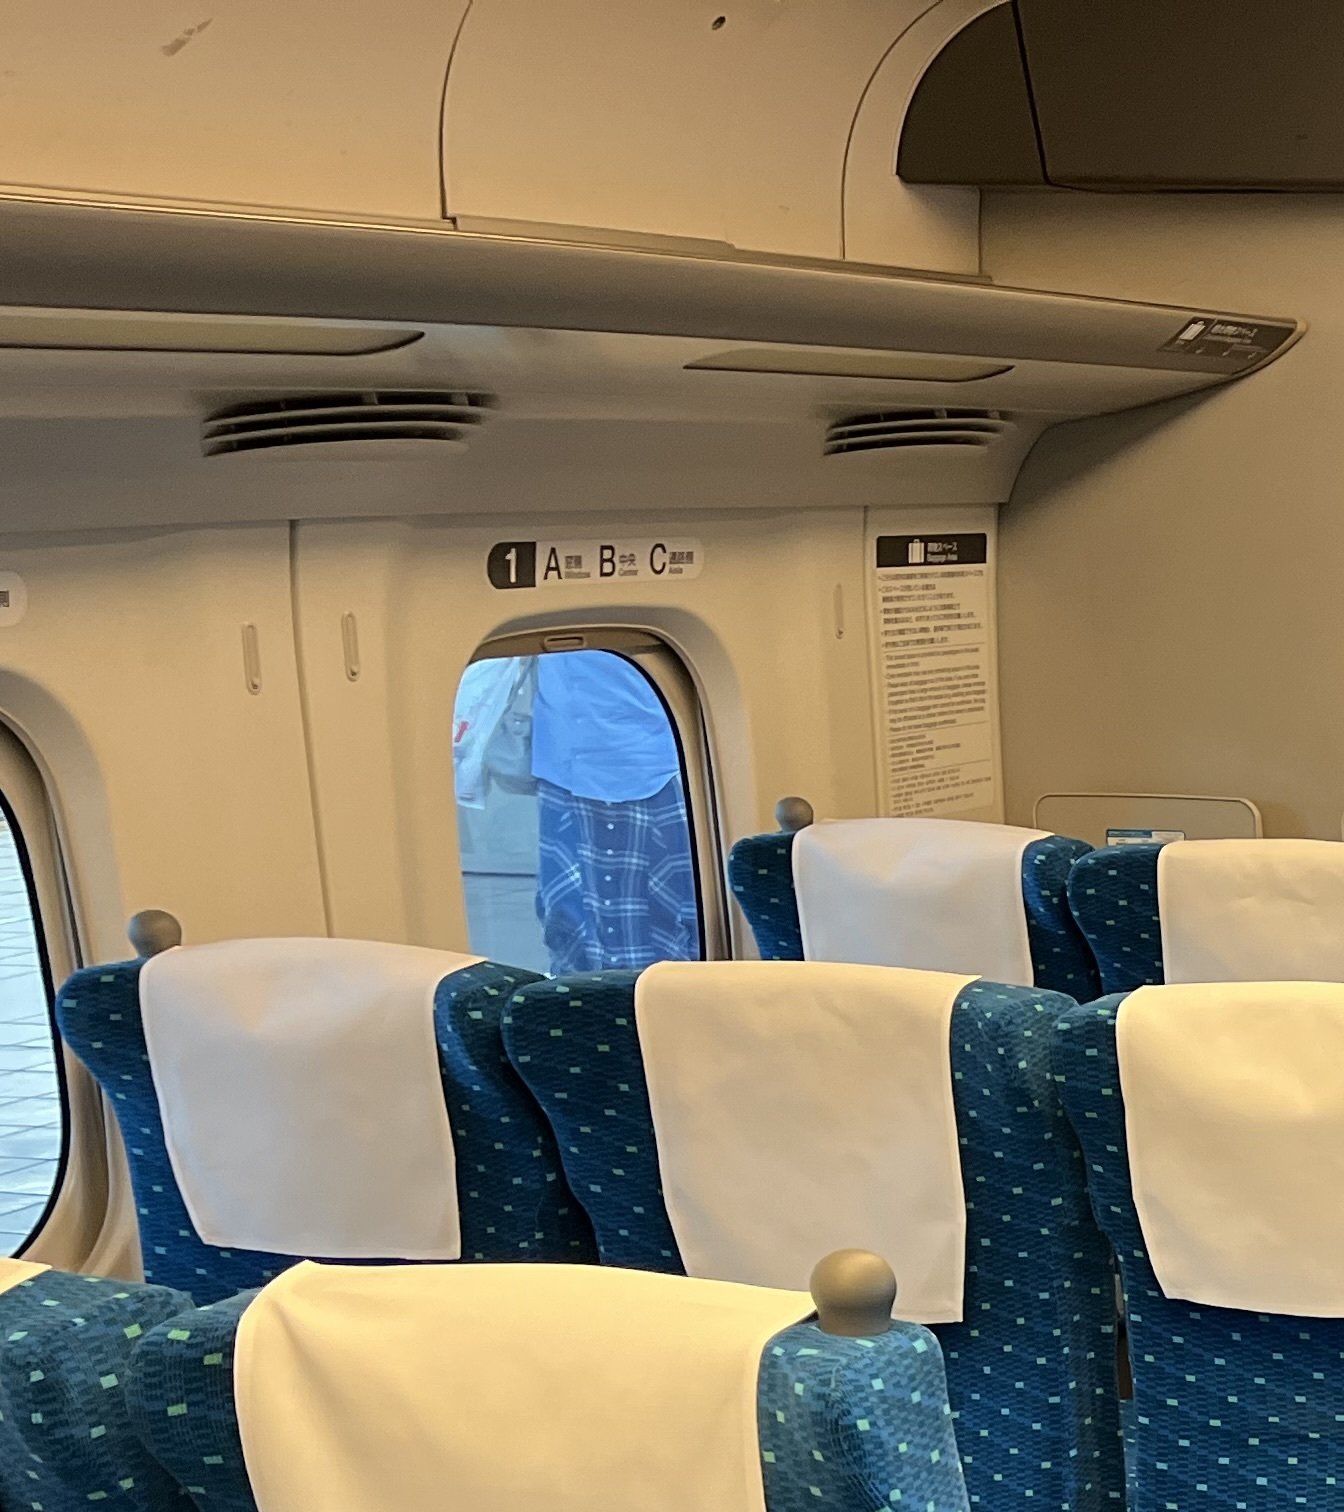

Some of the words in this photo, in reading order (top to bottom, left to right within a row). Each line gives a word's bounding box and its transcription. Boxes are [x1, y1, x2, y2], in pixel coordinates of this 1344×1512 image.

[505, 548, 517, 584] 1
[543, 547, 562, 580] A
[600, 545, 616, 577] B
[650, 543, 667, 575] C
